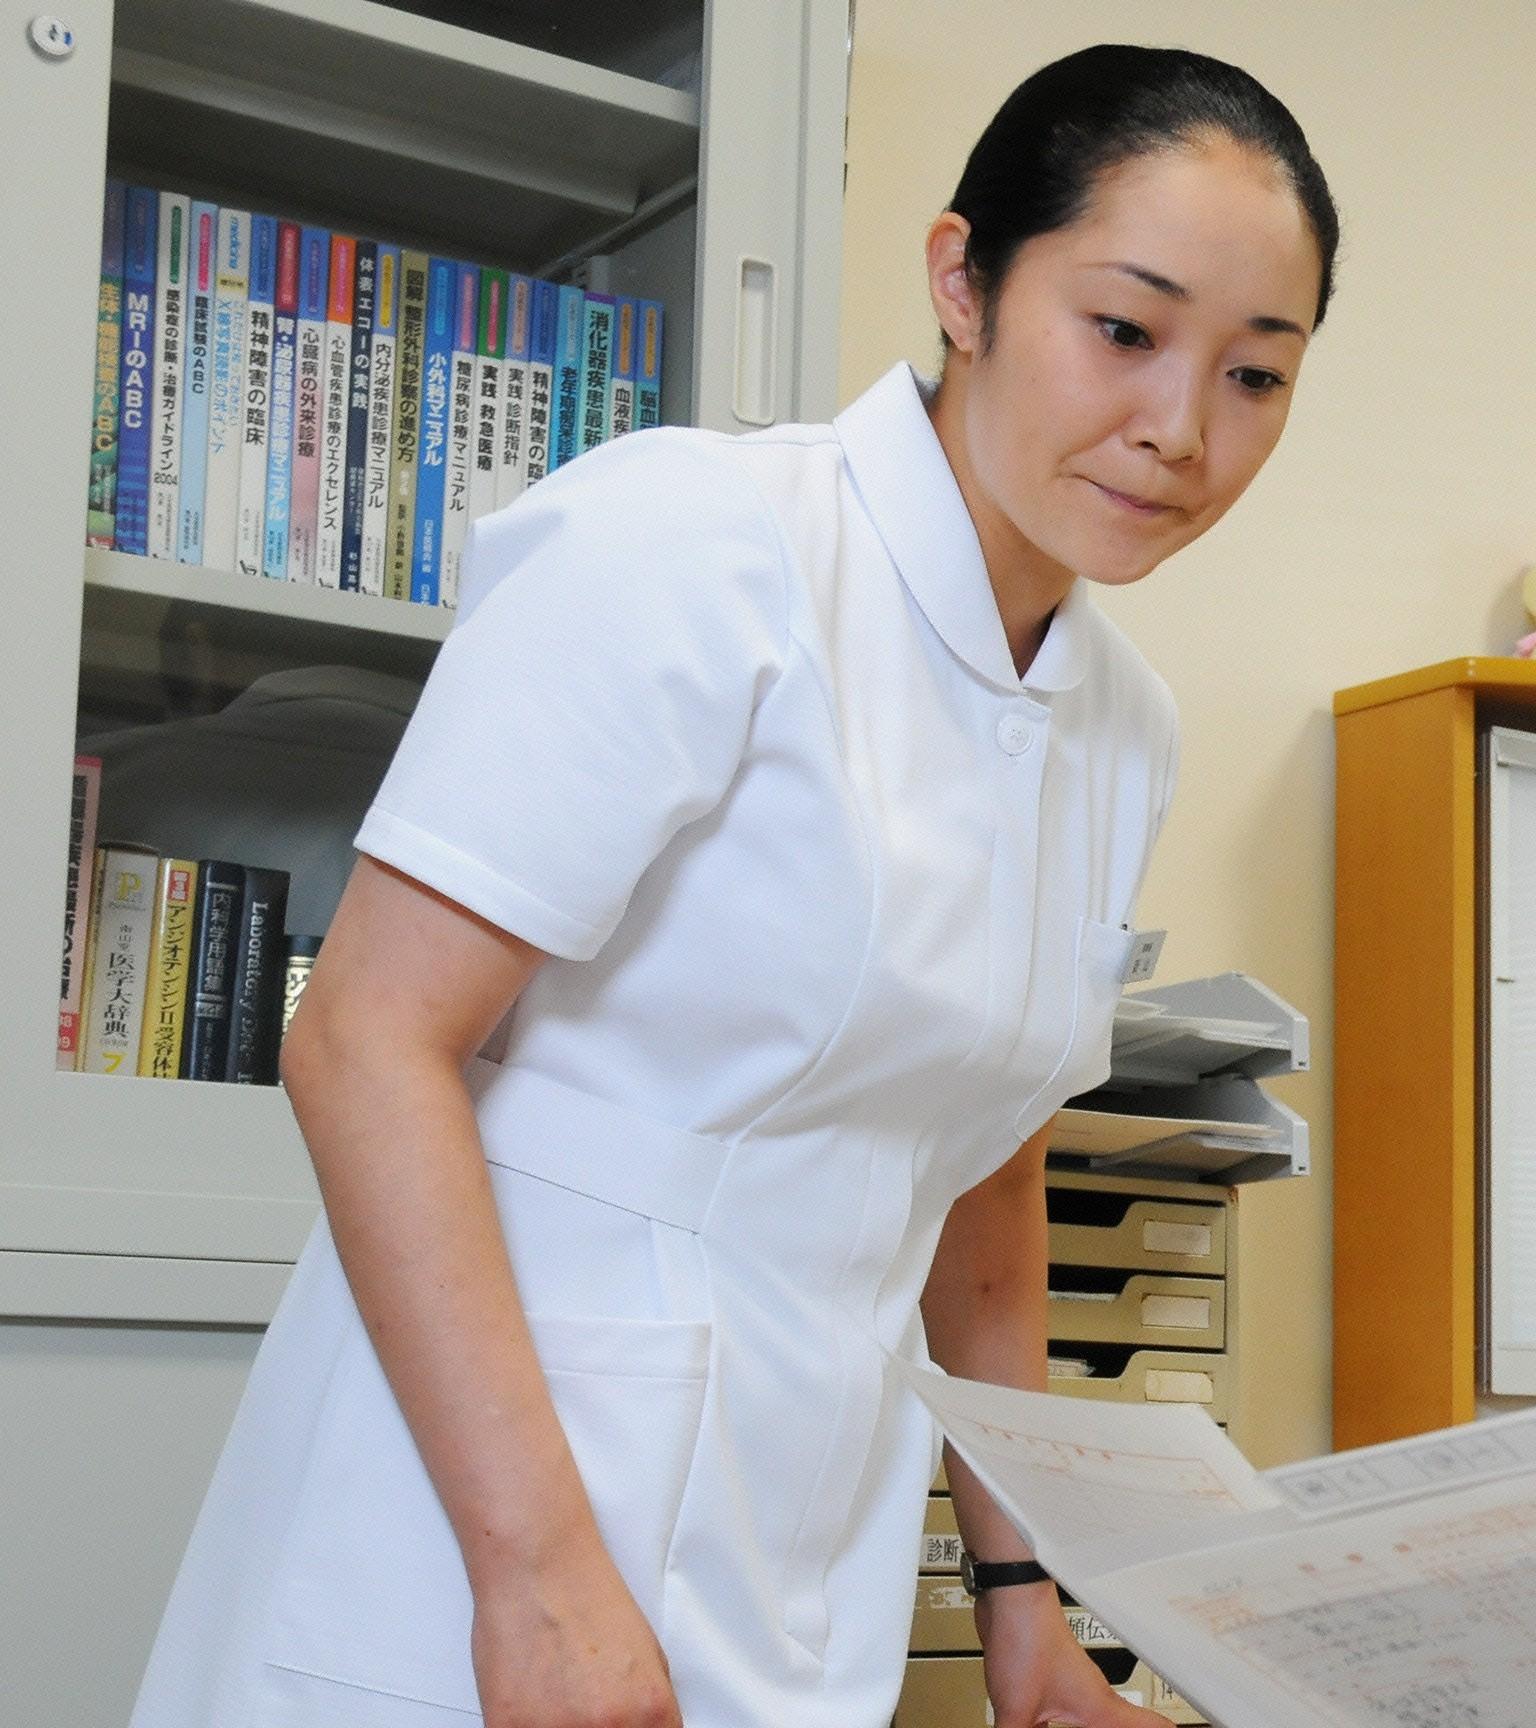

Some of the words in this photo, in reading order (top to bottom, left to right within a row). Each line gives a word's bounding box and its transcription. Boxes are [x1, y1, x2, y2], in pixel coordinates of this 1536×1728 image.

[124, 292, 149, 428] MRIのABC
[245, 311, 270, 446] 精神障害の臨床
[351, 257, 375, 410] 体表エコーの実践
[480, 365, 498, 399] 実践
[507, 368, 524, 400] 実践
[297, 328, 320, 458] 心臓病の外来診療
[323, 335, 346, 530] 心血管疾患診療のエクセレンス
[367, 343, 392, 509] 内分泌疾患診療マニュアル
[449, 360, 472, 512] 糖尿病診療マニュアル
[477, 403, 496, 472] 救急医療
[503, 401, 522, 468] 診断指針
[528, 371, 549, 487] 精神障害の臨
[613, 387, 631, 438] 血液疾
[103, 951, 135, 1037] 医学大辞典
[927, 1538, 960, 1563] 診断
